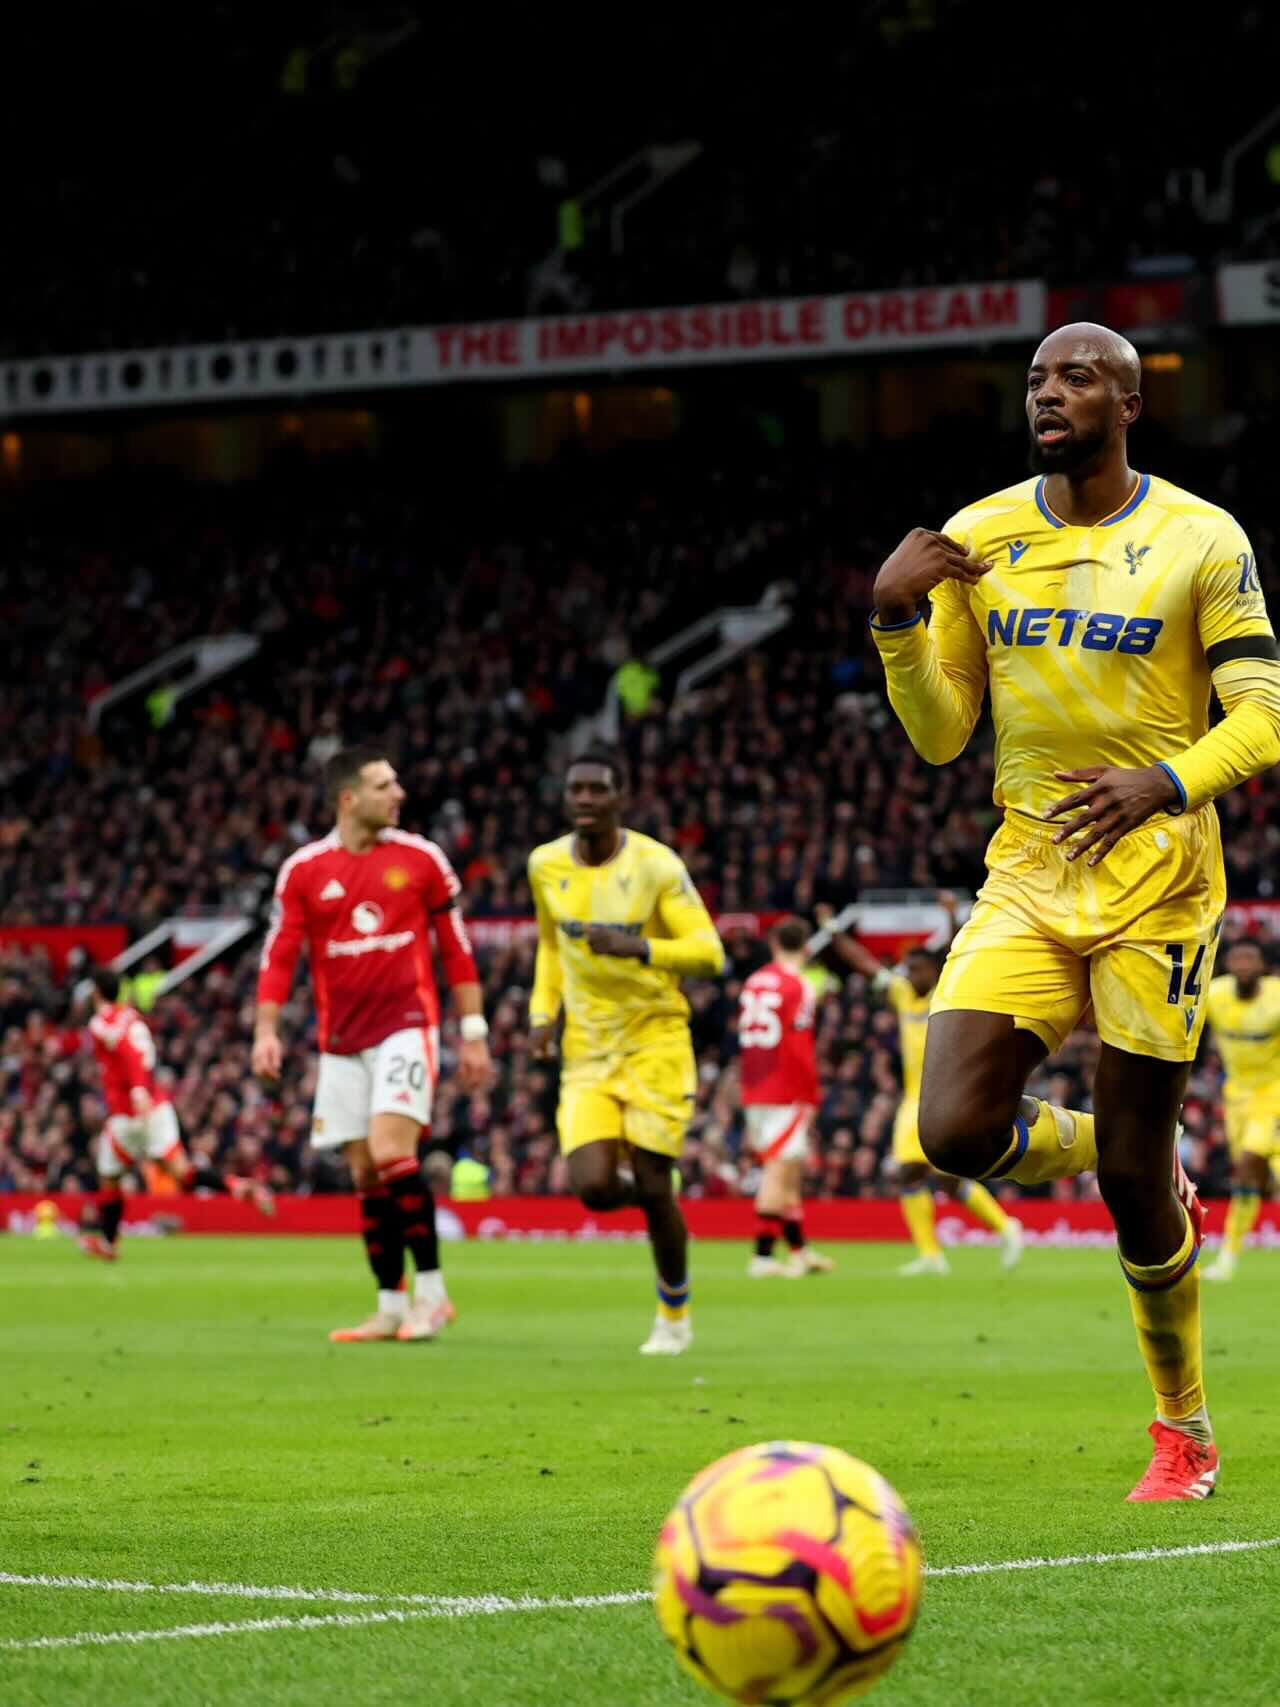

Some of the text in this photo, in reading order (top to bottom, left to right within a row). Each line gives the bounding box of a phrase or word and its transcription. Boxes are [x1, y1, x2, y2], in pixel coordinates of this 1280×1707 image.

[432, 285, 1020, 367] THE IMPOSSIBLE DREAM
[987, 608, 1164, 654] NET88
[1165, 943, 1208, 1005] 14
[387, 1055, 427, 1092] 20
